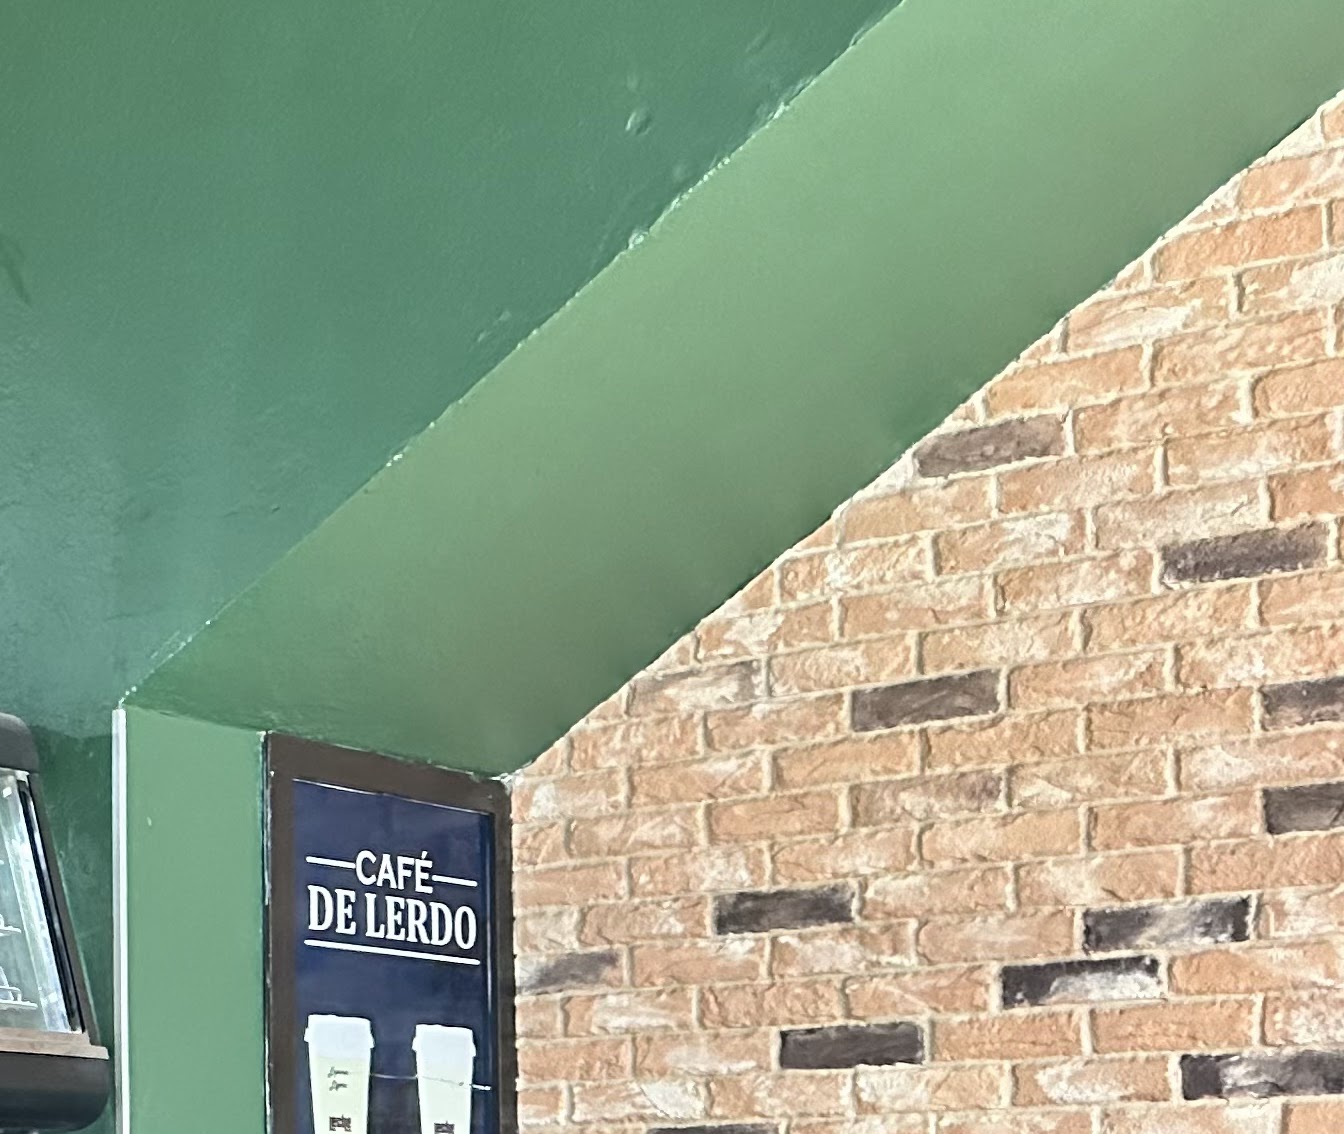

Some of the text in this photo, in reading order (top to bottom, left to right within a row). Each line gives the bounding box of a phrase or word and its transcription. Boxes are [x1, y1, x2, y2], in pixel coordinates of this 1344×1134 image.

[355, 850, 434, 894] CAFÉ
[307, 884, 477, 950] DE LERDO
